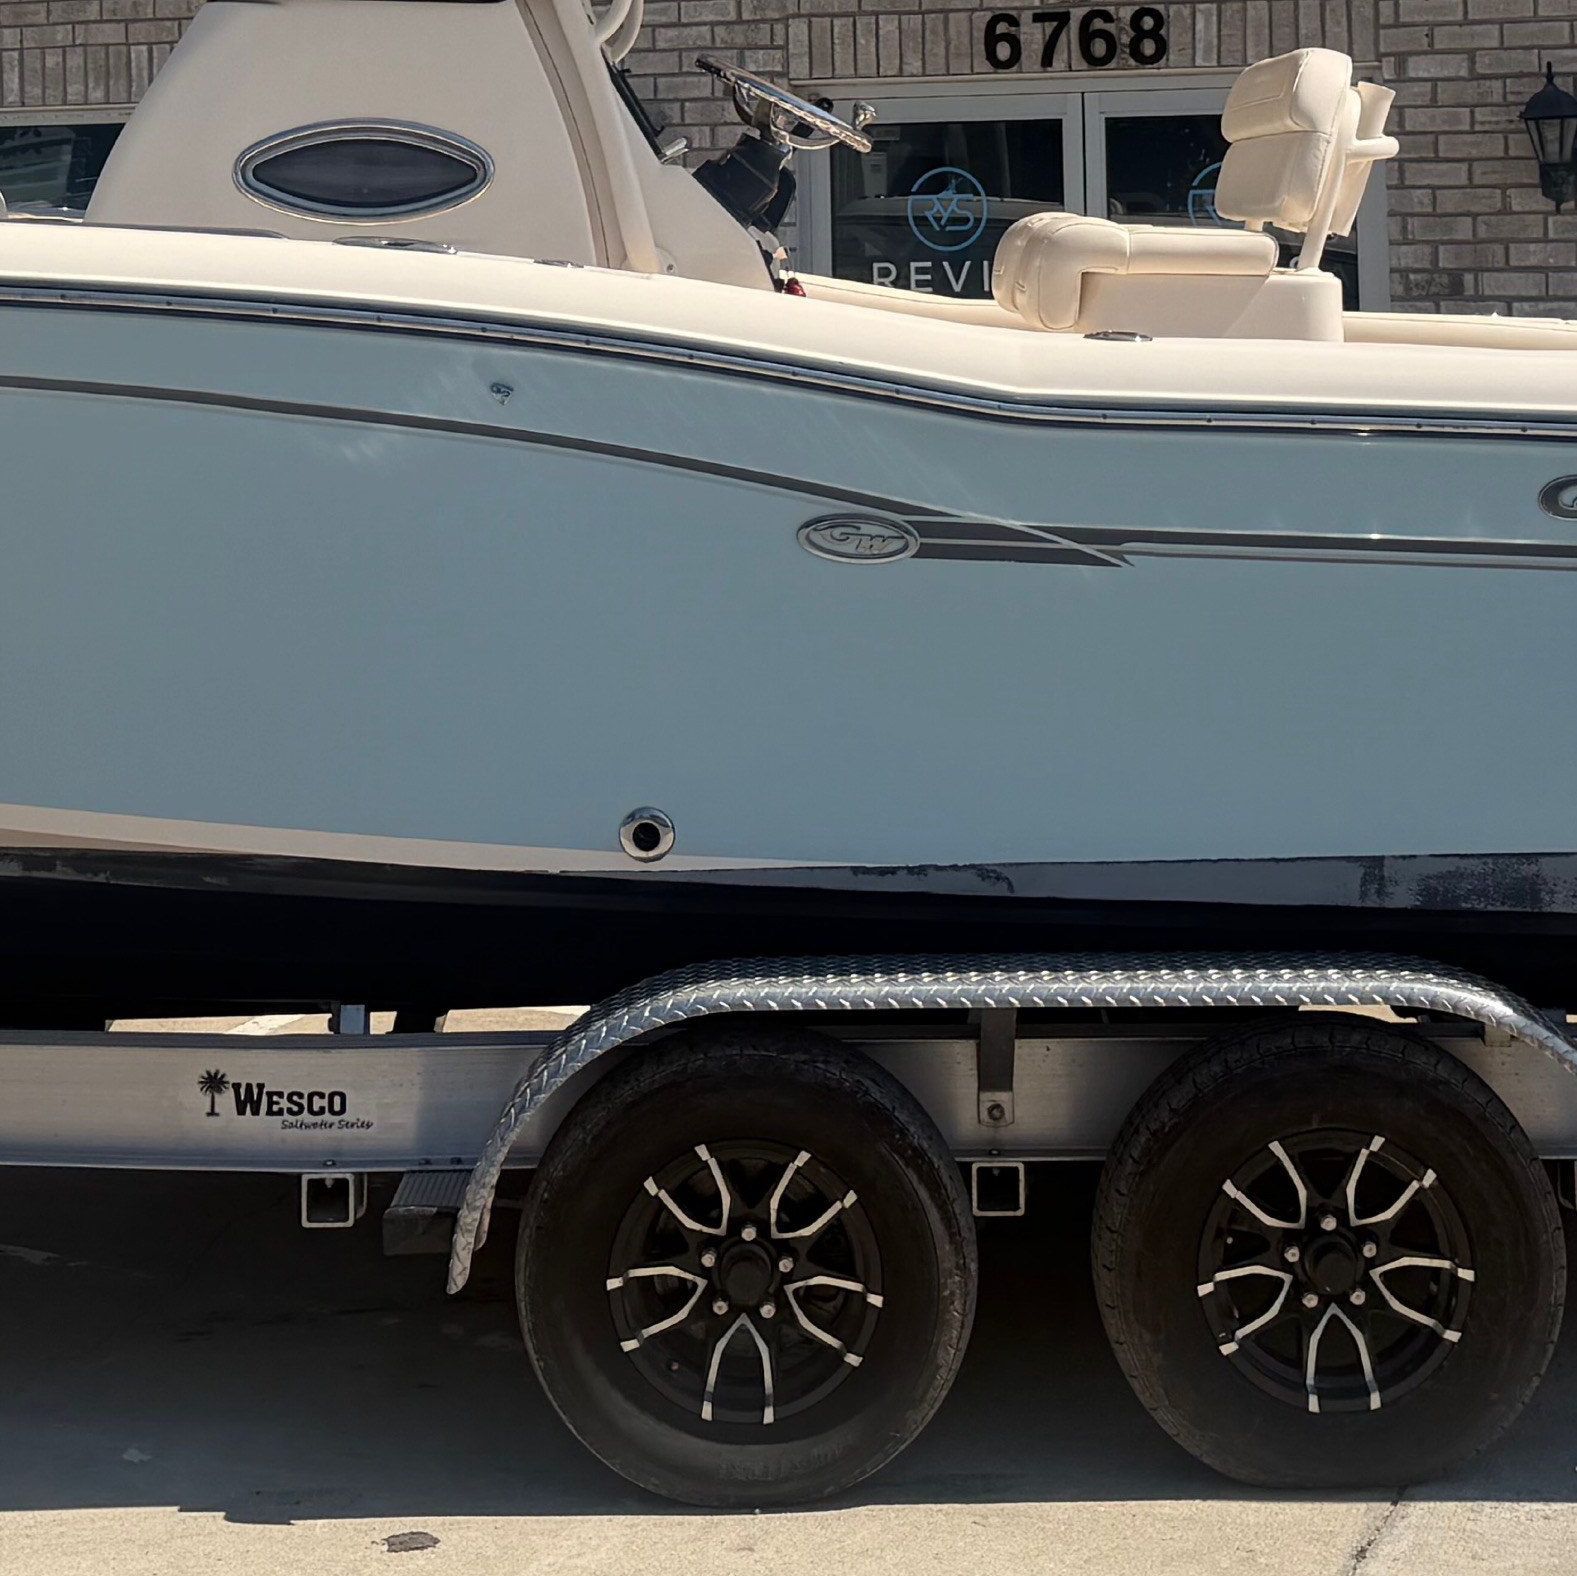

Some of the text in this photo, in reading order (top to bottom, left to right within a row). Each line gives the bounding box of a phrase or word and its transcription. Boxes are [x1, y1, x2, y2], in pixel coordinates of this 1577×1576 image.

[983, 6, 1170, 71] 6768
[872, 260, 991, 292] REVI
[280, 1118, 374, 1131] Saltwater Series
